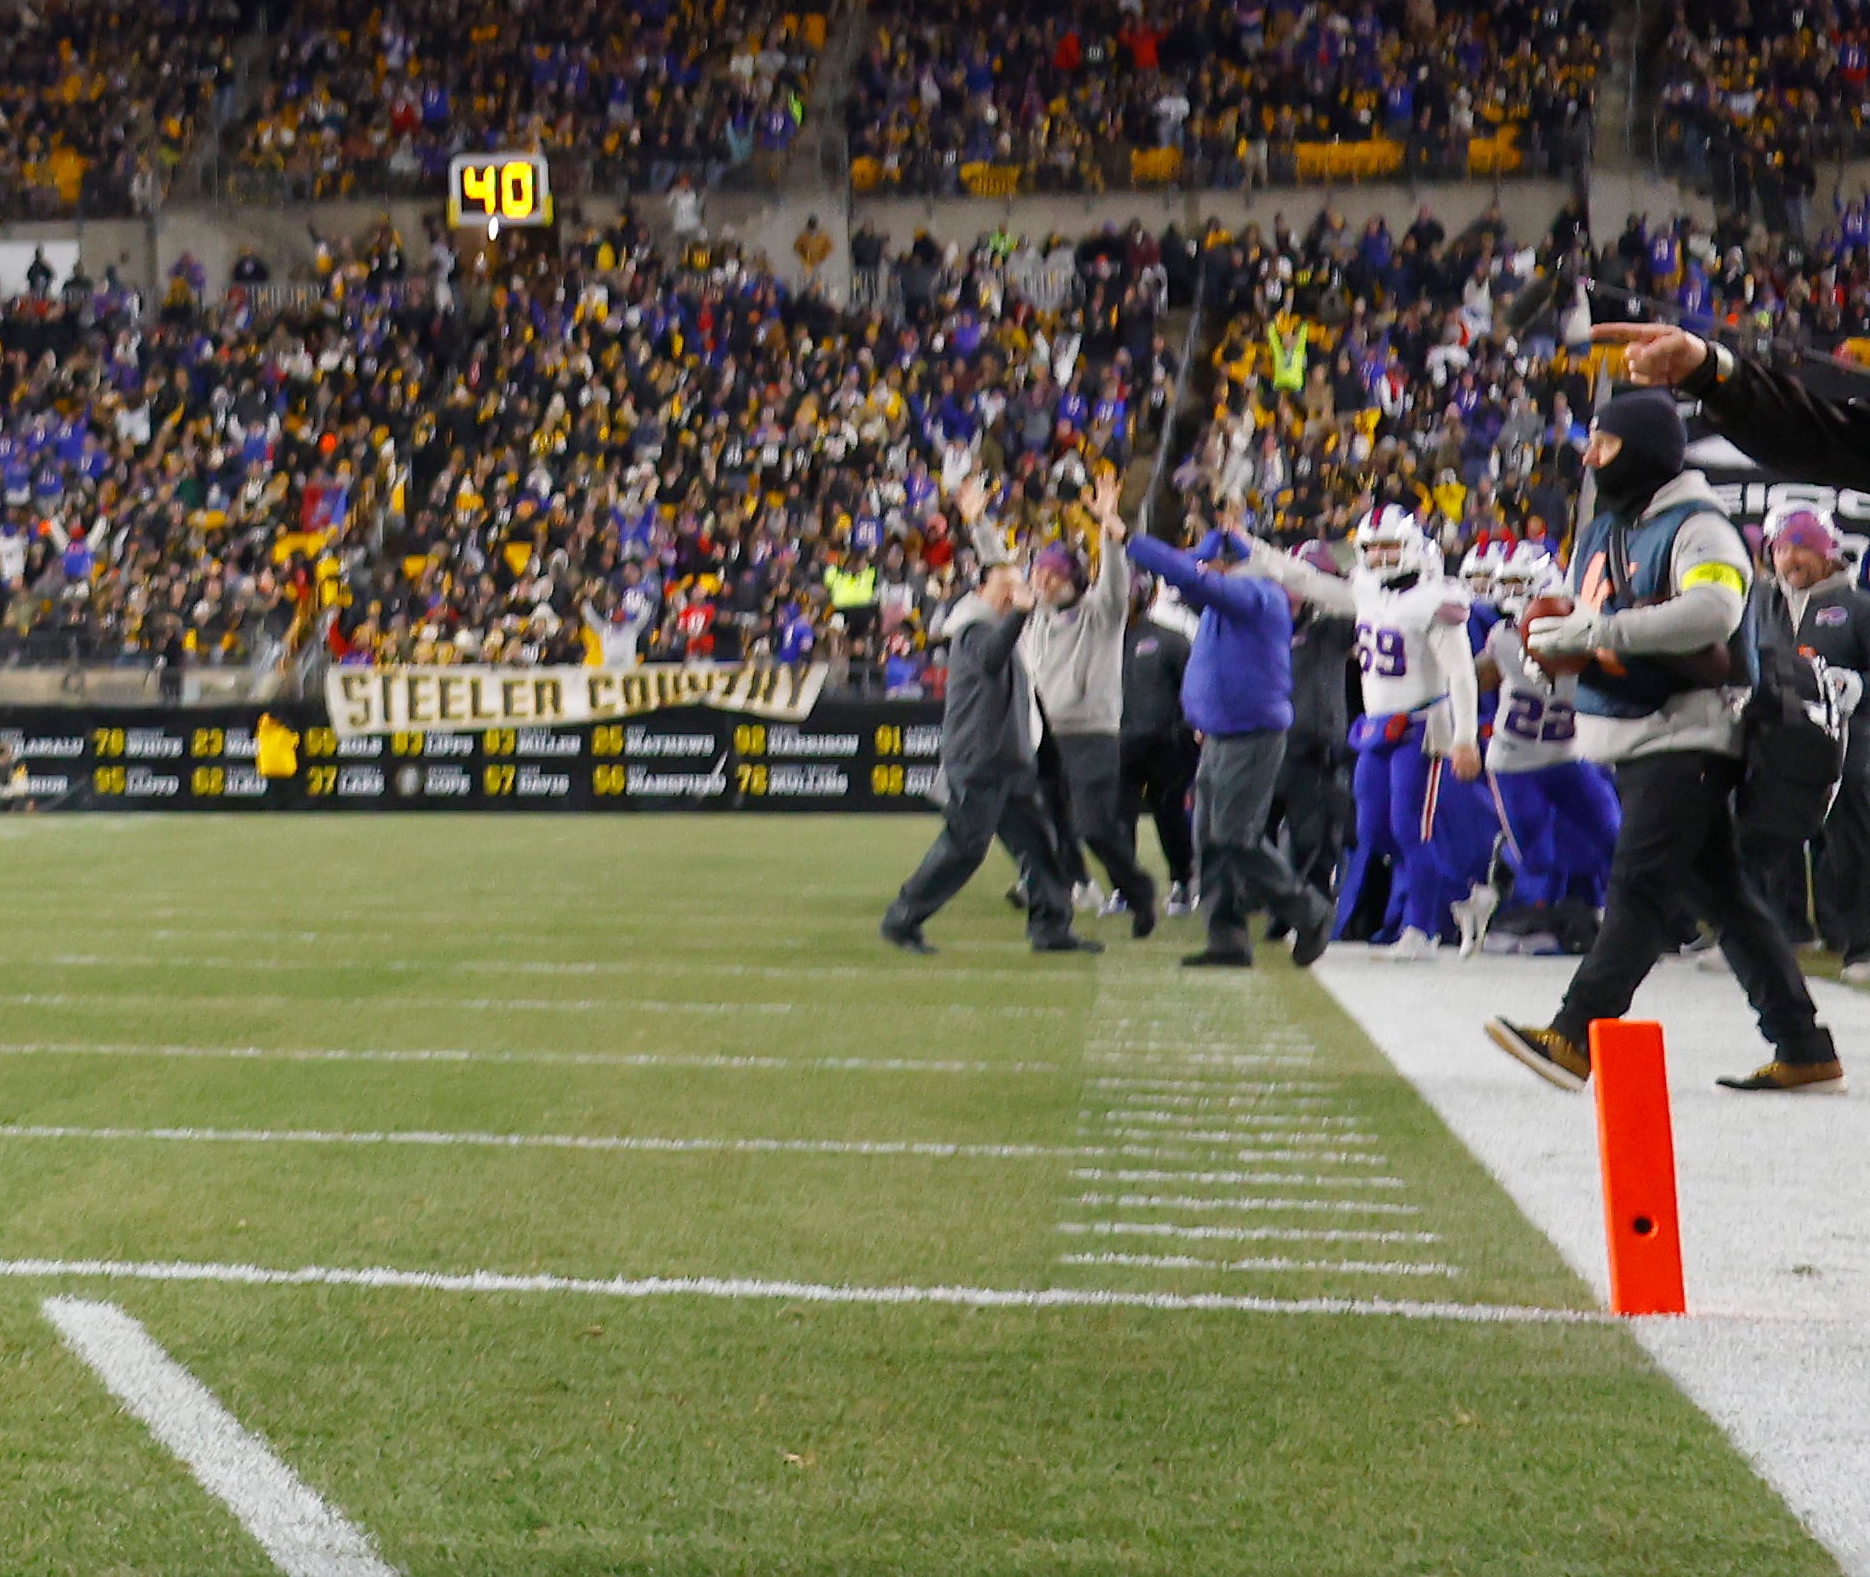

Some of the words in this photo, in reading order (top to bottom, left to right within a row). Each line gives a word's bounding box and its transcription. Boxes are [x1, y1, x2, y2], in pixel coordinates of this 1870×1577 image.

[463, 160, 533, 220] 40
[1356, 622, 1408, 677] 69
[342, 672, 562, 727] STEELER
